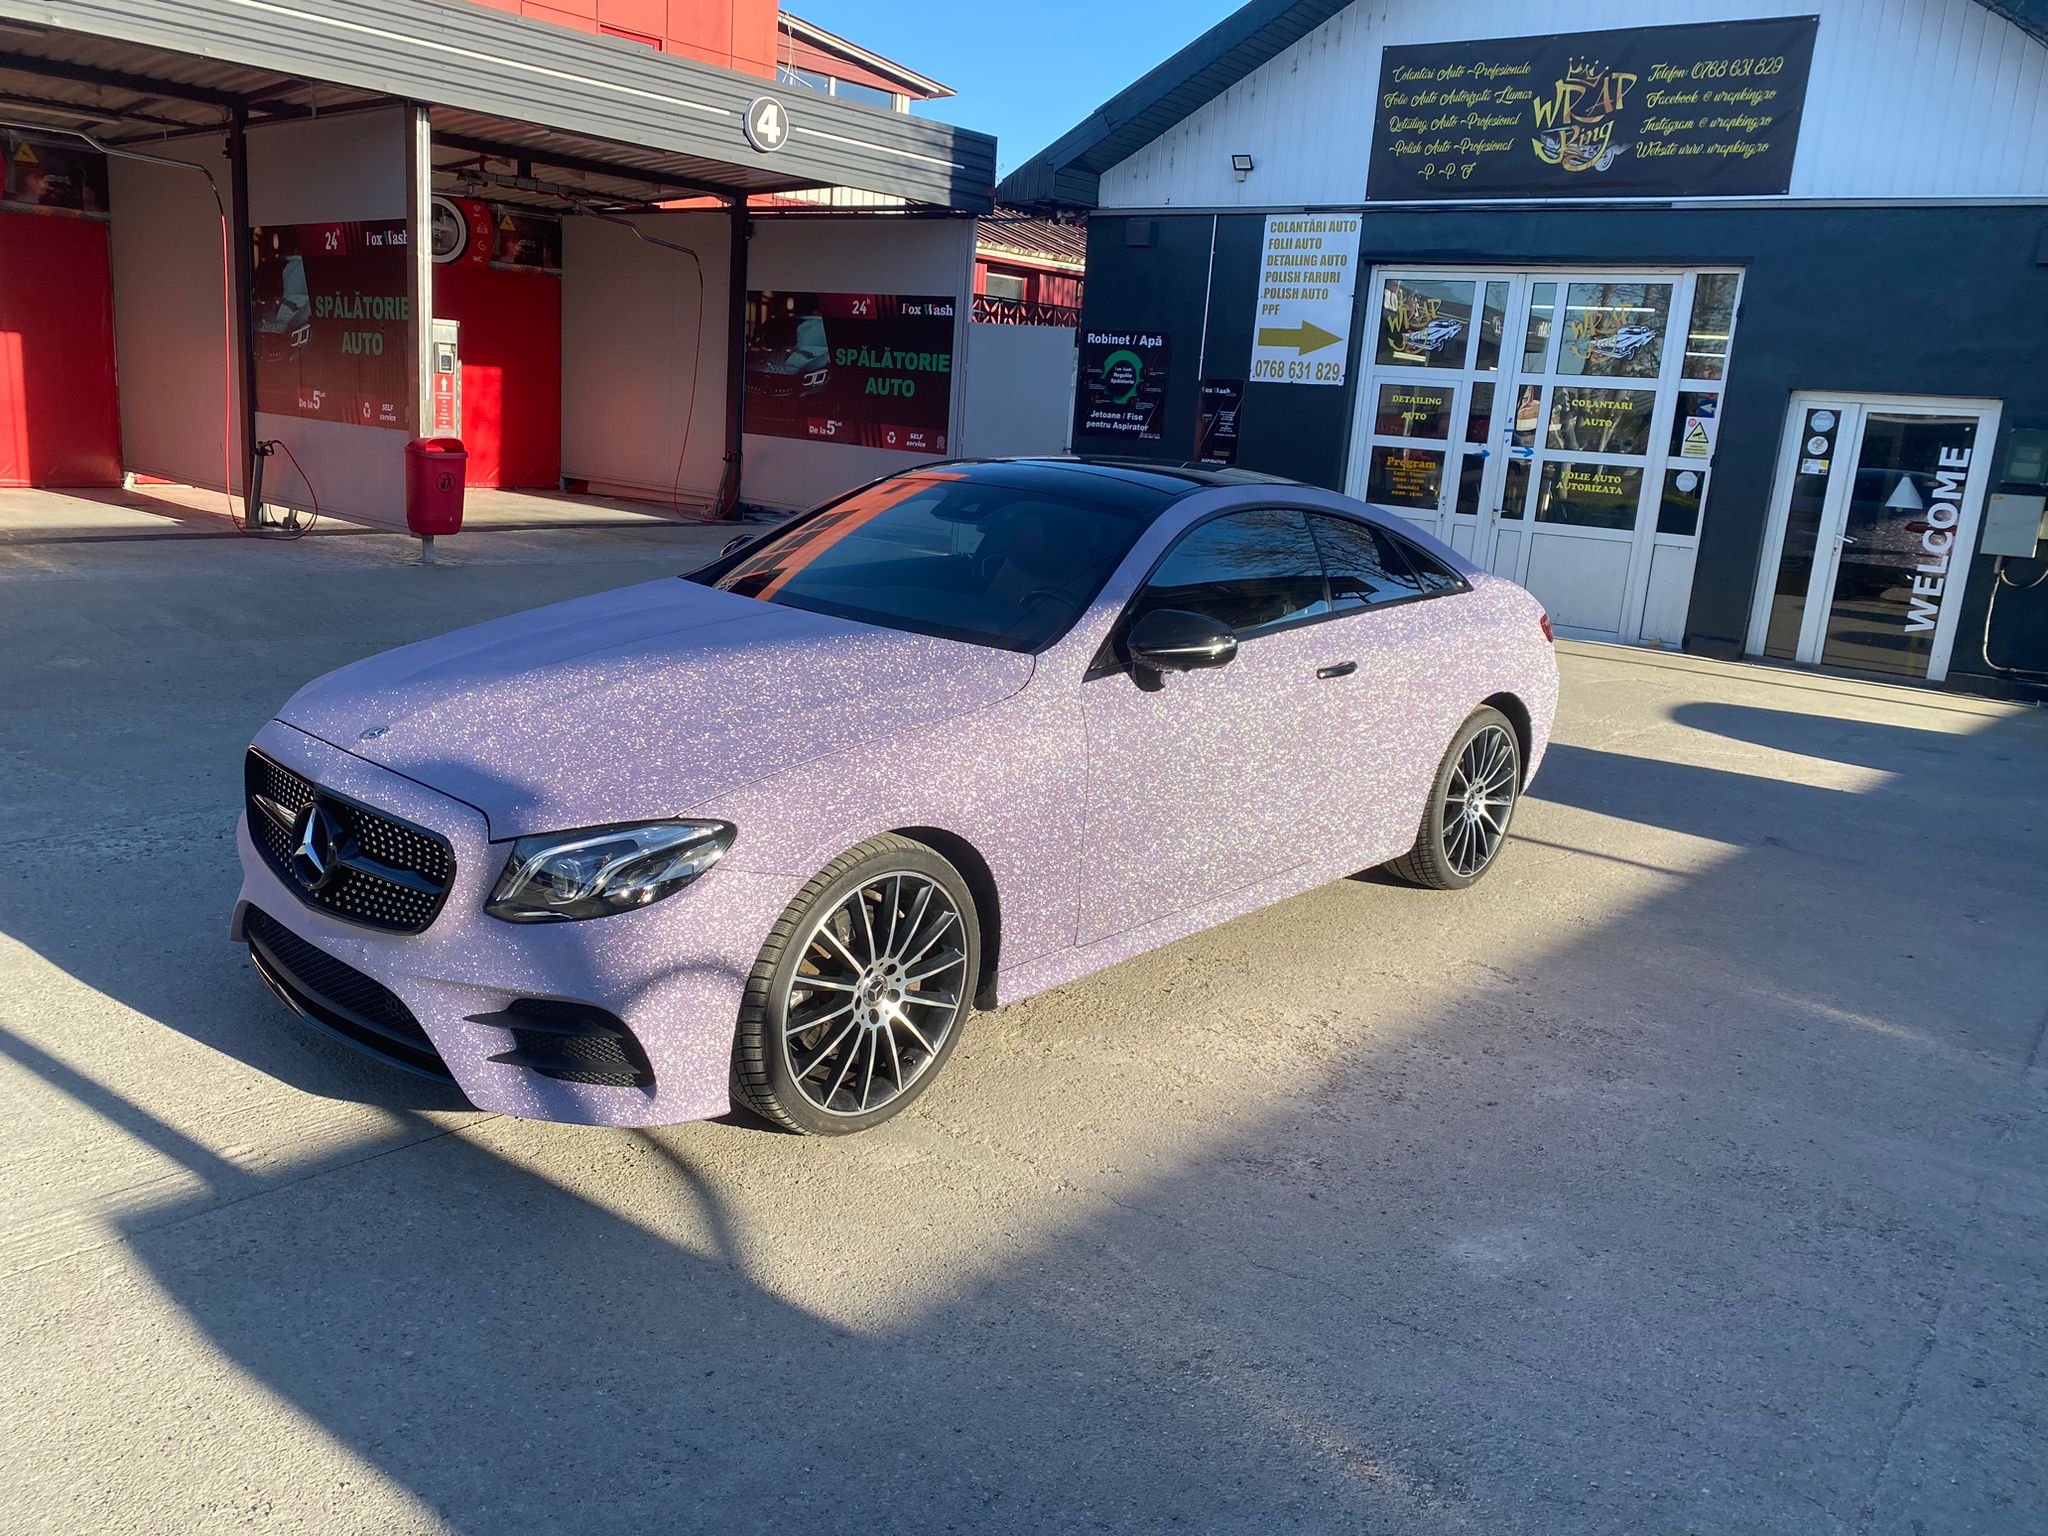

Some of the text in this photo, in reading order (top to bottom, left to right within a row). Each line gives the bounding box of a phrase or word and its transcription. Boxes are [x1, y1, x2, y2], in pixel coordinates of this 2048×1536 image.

[1437, 64, 1465, 81] Auto
[1467, 61, 1532, 80] Profesionale
[1691, 60, 1728, 79] 0768
[1729, 58, 1754, 77] 631
[1754, 56, 1784, 75] 829
[1384, 91, 1408, 108] Folie
[1410, 90, 1438, 107] Auto
[1533, 72, 1638, 128] WRAP
[1646, 89, 1700, 108] Facebook
[1714, 87, 1776, 106] wrapking.ro
[757, 103, 780, 143] 4
[1390, 112, 1522, 134] Detailing Auto Profesional
[1640, 117, 1694, 136] Instagram
[1710, 113, 1773, 132] wrapking.ro
[1389, 137, 1515, 156] Polish Auto Profesional
[1636, 140, 1679, 158] Website
[1328, 220, 1357, 233] AUTO
[1268, 238, 1323, 250] FOLII AUTO
[1267, 255, 1348, 267] DETAILING AUTO
[1265, 271, 1341, 283] POLISH FARURI
[1264, 287, 1329, 300] POLISH AUTO
[315, 291, 409, 320] SPĂLĂTORIE
[924, 304, 953, 317] Wash
[1262, 304, 1280, 316] PPF
[341, 332, 384, 355] AUTO
[1087, 333, 1130, 345] Robinet
[1140, 335, 1163, 348] Apă
[835, 346, 950, 372] SPĂLĂTORIE
[1255, 360, 1341, 381] 0768 631 829
[864, 377, 916, 397] AUTO
[313, 390, 320, 409] 5
[1392, 395, 1442, 405] DETAILING
[1571, 399, 1633, 410] COLANTARI
[382, 403, 394, 412] SELF
[379, 413, 397, 422] service
[1090, 410, 1121, 421] Jetoane
[1401, 412, 1427, 420] AUTO
[1583, 418, 1613, 427] AUTO
[826, 420, 836, 435] 5
[1086, 421, 1149, 432] pentru Aspirator
[906, 440, 926, 448] service
[1387, 456, 1437, 469] Program
[1561, 471, 1622, 484] FOLIE AUTO
[1556, 481, 1623, 495] AUTORIZATA
[1904, 446, 1972, 633] WELCOME
